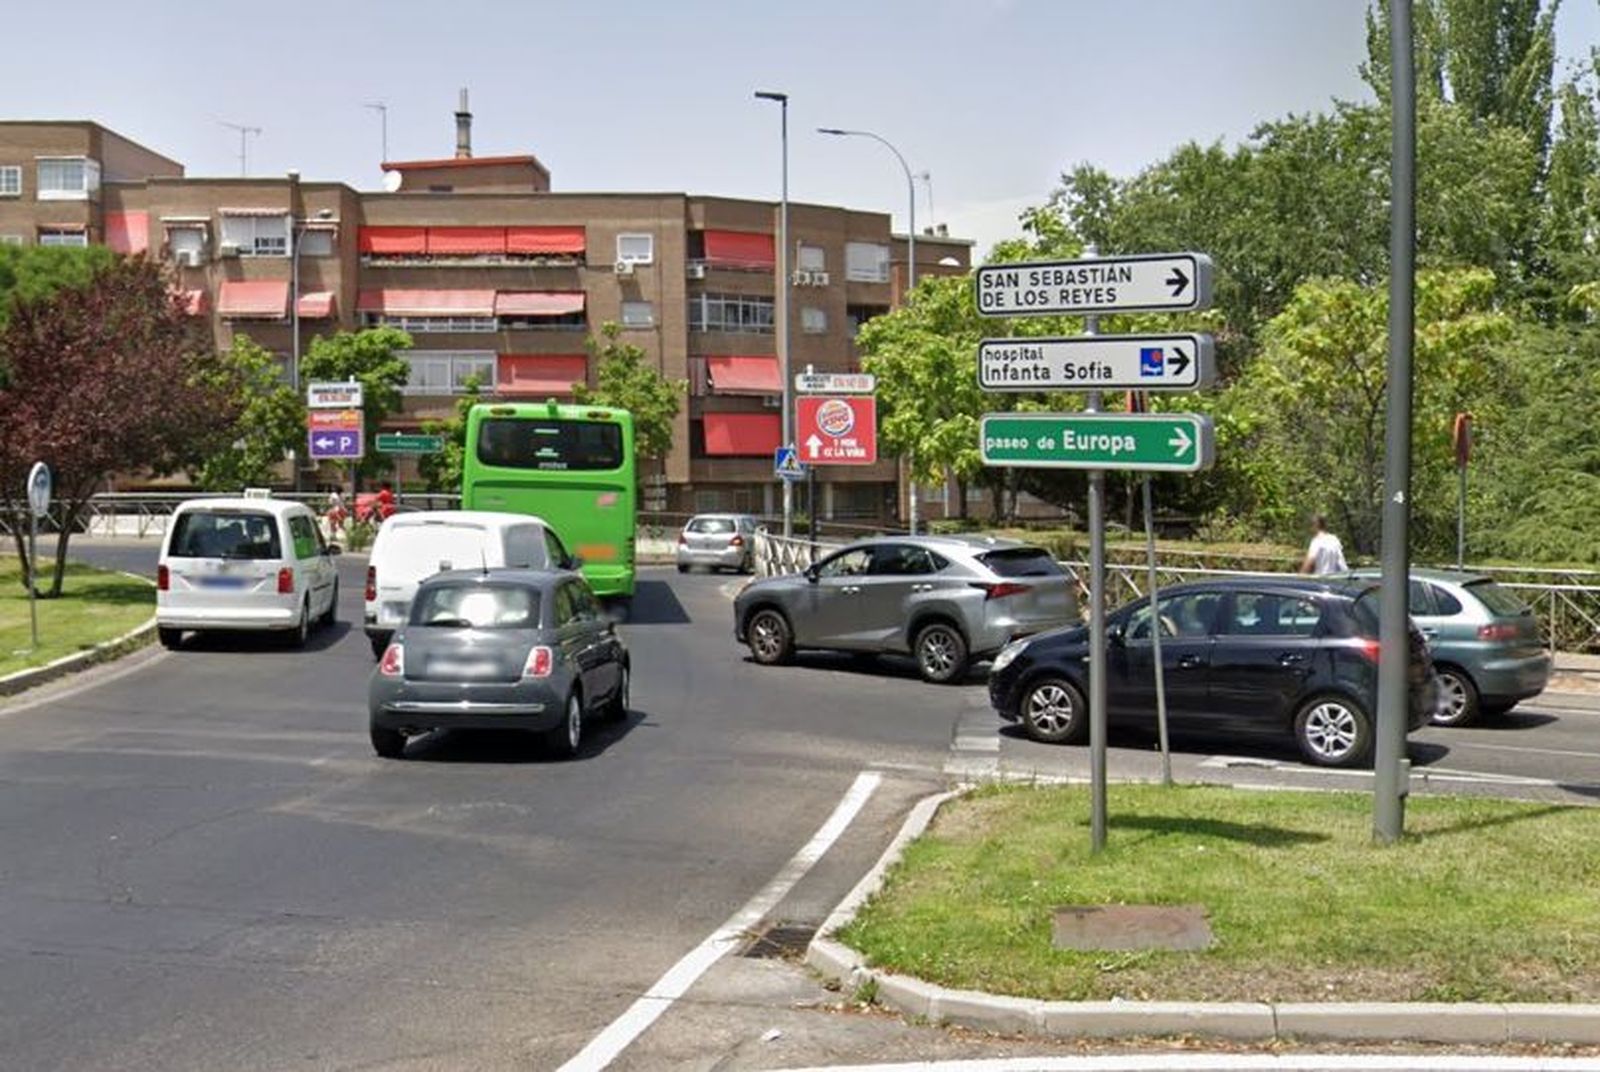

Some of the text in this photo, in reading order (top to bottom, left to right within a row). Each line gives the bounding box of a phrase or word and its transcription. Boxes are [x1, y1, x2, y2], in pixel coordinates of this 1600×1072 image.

[983, 264, 1132, 289] SAN SEBASTIÁN
[982, 287, 1116, 308] DE LOS REYES
[984, 347, 1044, 362] hospital
[985, 363, 1051, 381] Infanta
[340, 436, 351, 451] P
[986, 430, 1136, 455] paseo de Europa
